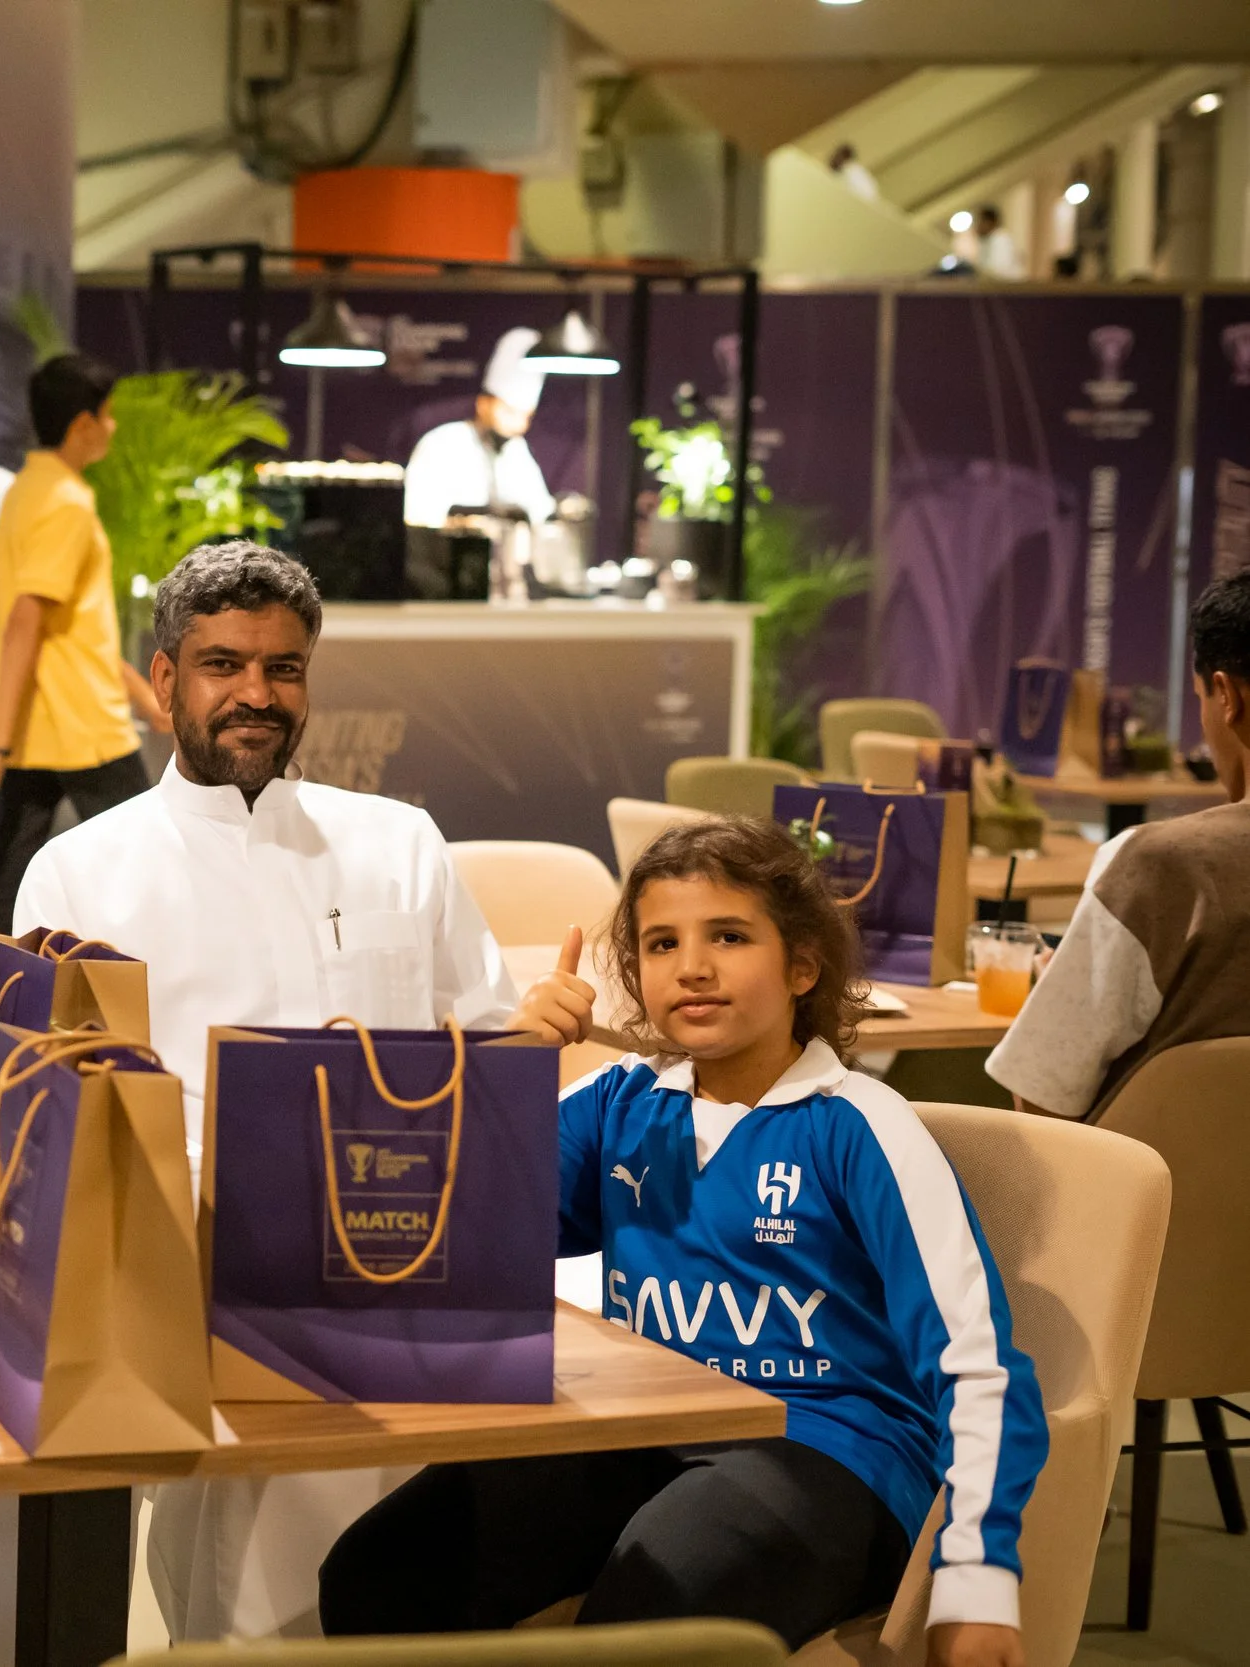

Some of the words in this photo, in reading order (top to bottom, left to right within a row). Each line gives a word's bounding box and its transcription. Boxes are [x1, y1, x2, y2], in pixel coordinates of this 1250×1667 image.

[346, 1211, 429, 1231] MATCH
[753, 1216, 797, 1232] ALHILAL
[755, 1230, 795, 1245] الهلال
[609, 1268, 827, 1348] SAVVY
[706, 1358, 831, 1378] GROUP
